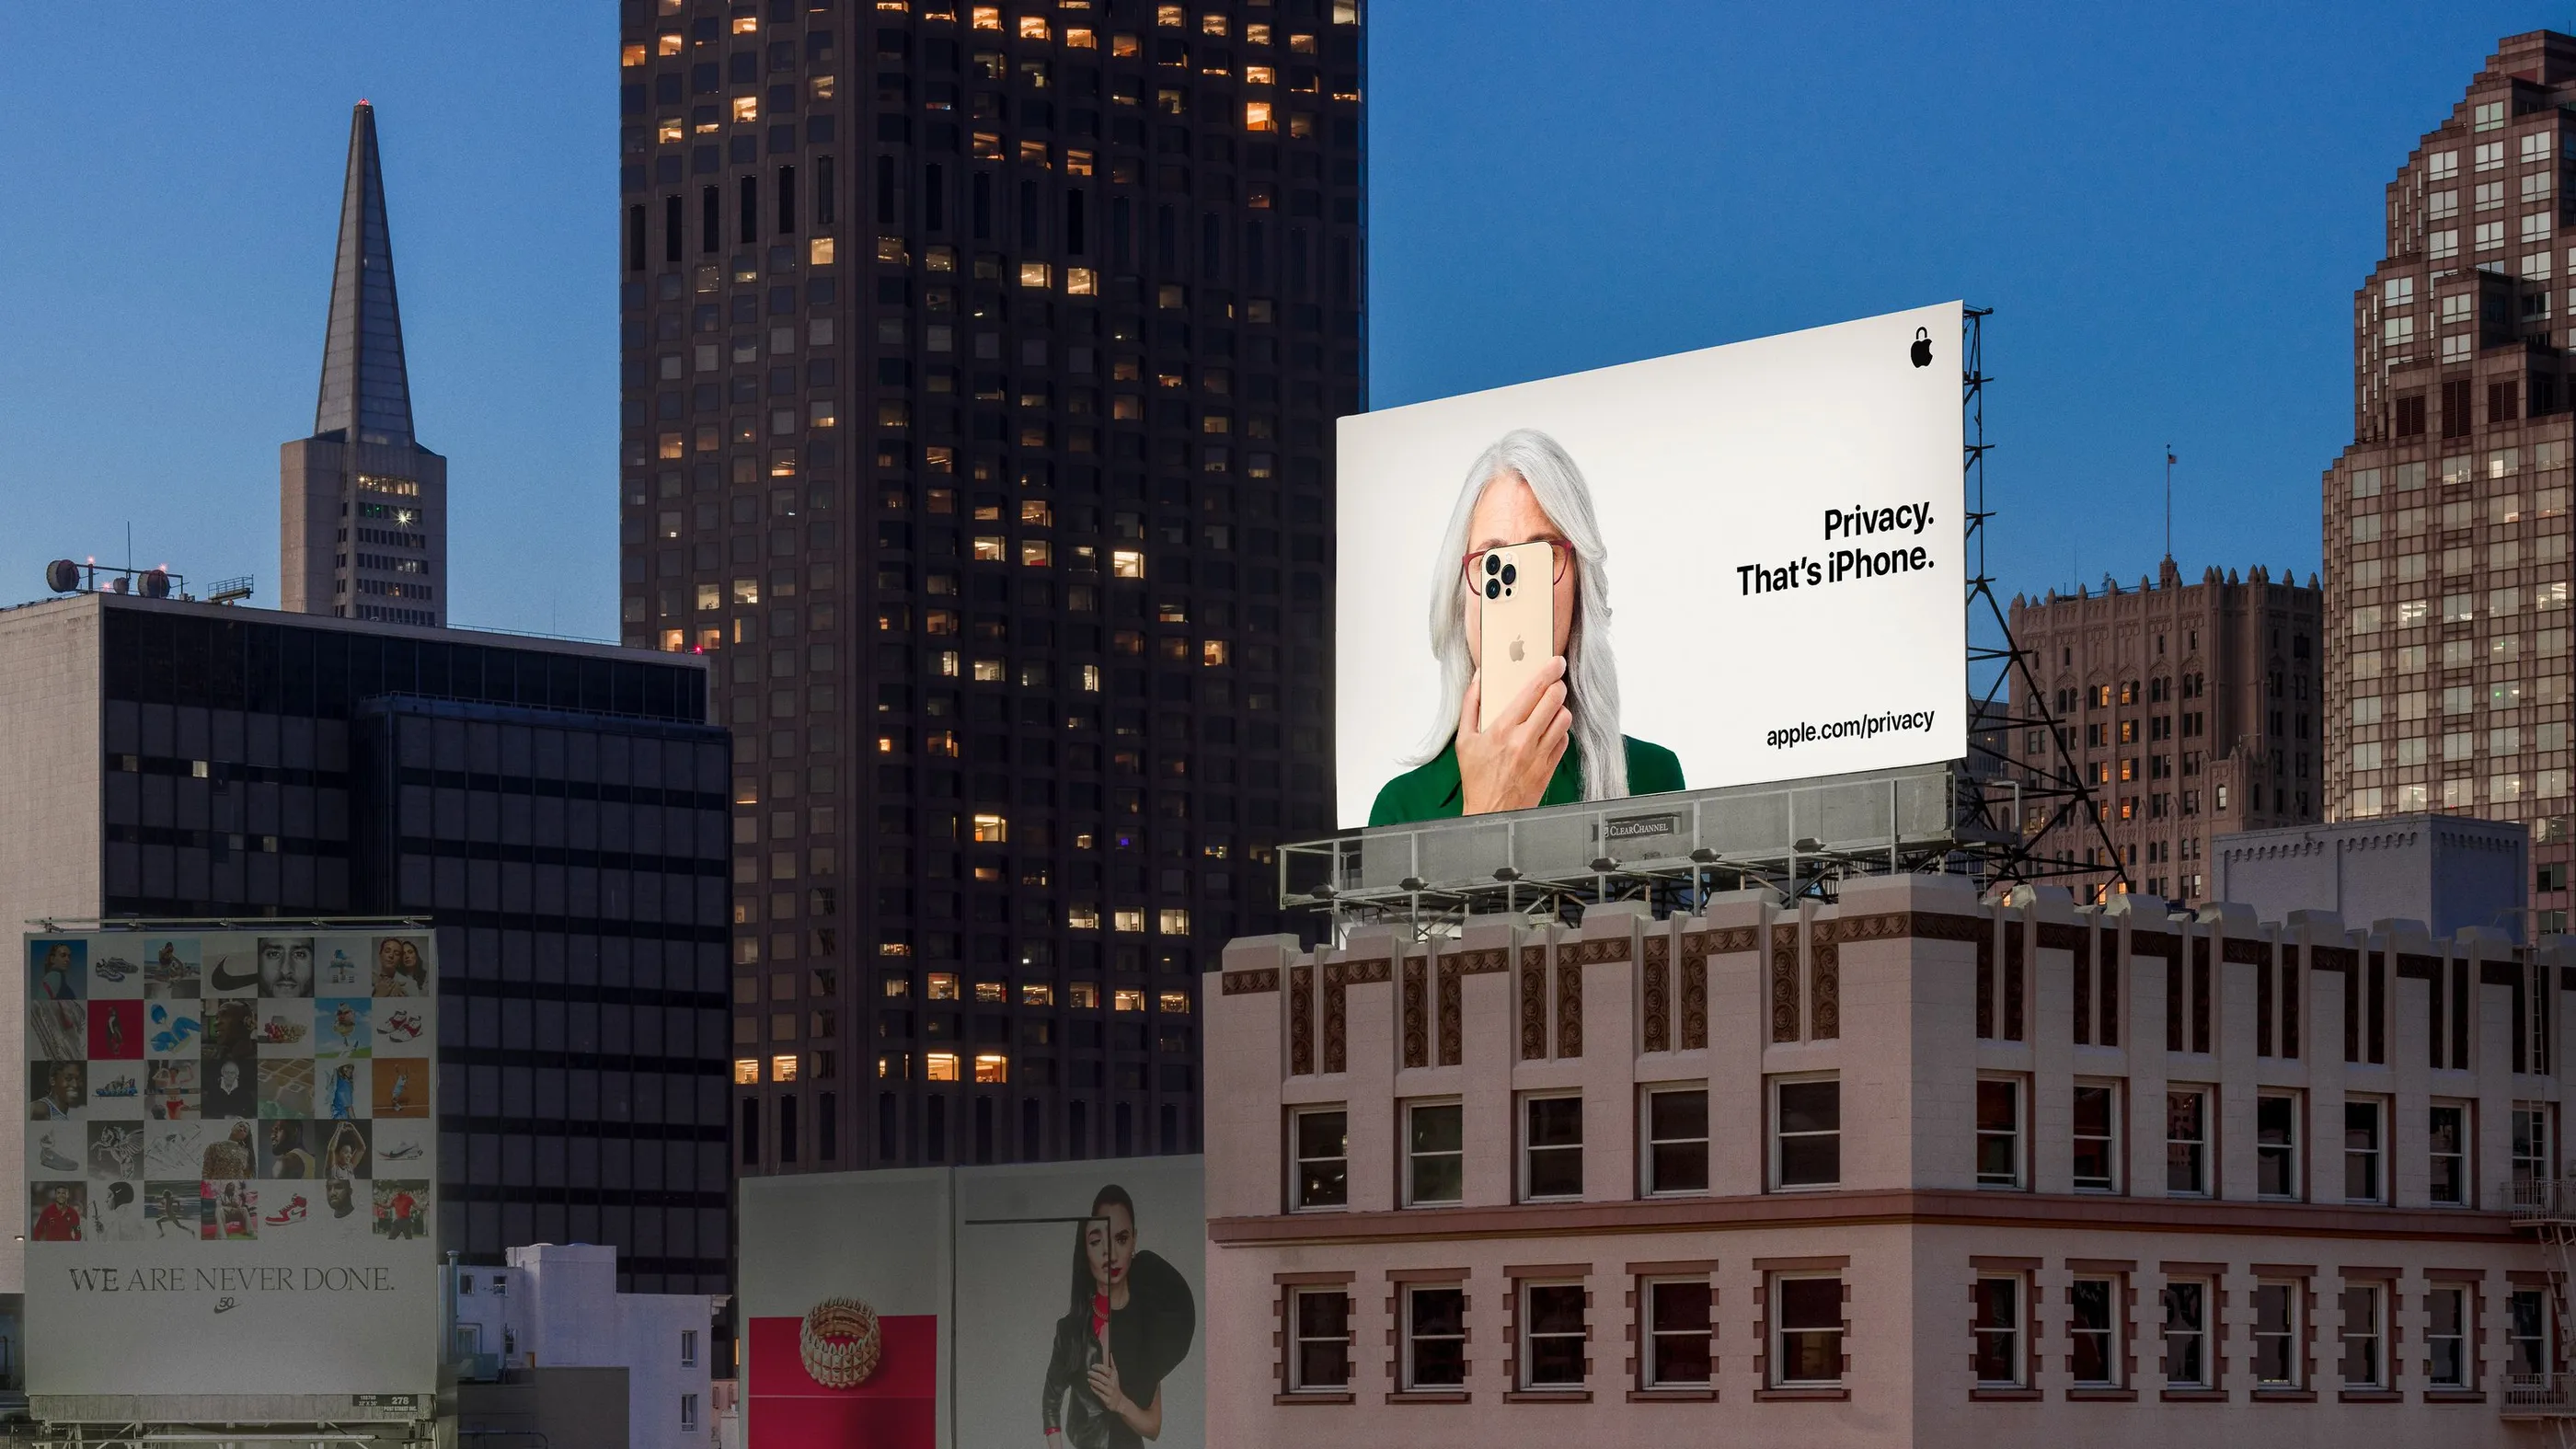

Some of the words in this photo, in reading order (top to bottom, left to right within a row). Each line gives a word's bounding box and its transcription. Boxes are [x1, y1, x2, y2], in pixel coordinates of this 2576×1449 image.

[1824, 501, 1934, 540] Privacy.
[1737, 557, 1822, 595] That’s
[1828, 546, 1935, 582] iPhone.
[1766, 710, 1935, 749] apple.com/privacy
[69, 1268, 120, 1292] WE
[125, 1268, 186, 1292] ARE
[194, 1268, 294, 1291] NEVER
[303, 1267, 396, 1291] DONE.
[219, 1296, 235, 1308] 50
[392, 1397, 409, 1405] 278
